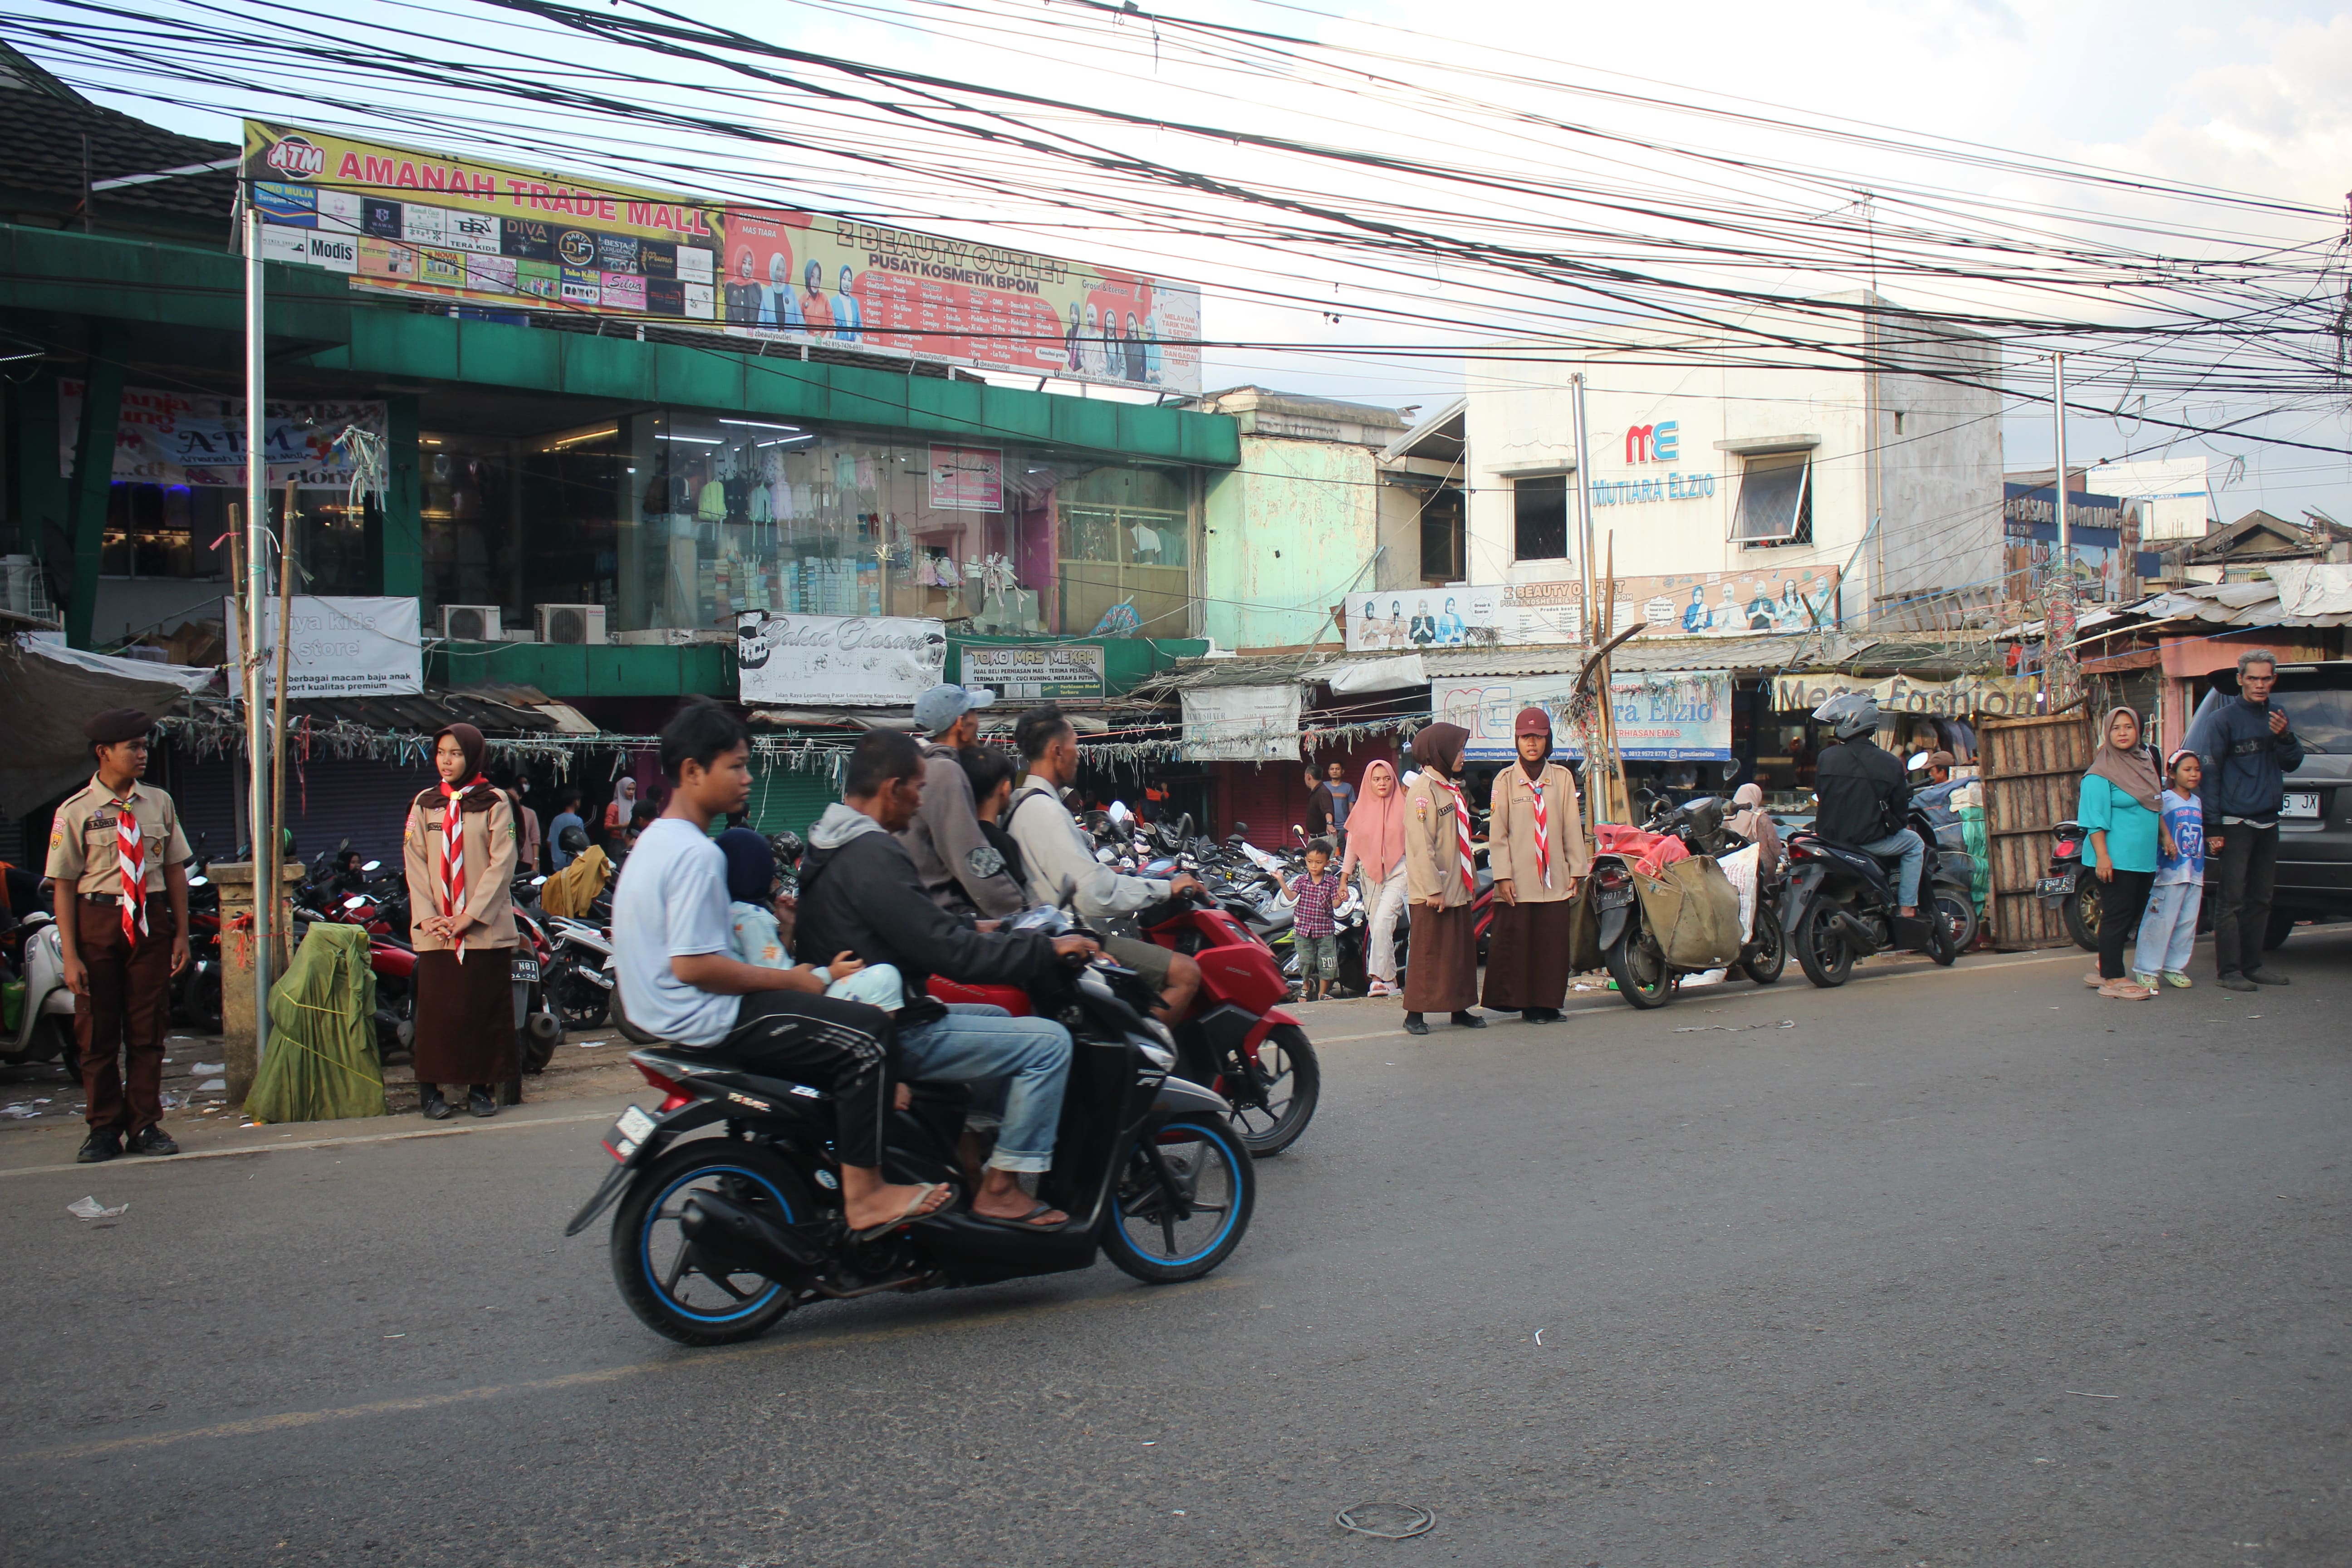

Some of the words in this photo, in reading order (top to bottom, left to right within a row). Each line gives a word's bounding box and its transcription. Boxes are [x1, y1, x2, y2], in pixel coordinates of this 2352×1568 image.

[268, 141, 325, 174] ATM
[257, 182, 282, 194] TOKO
[284, 187, 314, 199] MULIA
[337, 151, 495, 202] AMANAH
[505, 177, 617, 221] TRADE
[627, 200, 710, 236] MALL
[258, 194, 286, 204] Seragam
[761, 216, 781, 226] TOKO
[507, 220, 547, 238] DIVA
[742, 225, 757, 235] MAS
[757, 228, 777, 238] TIARA
[450, 240, 473, 249] TERA
[476, 244, 496, 252] KIDS
[604, 238, 628, 249] BESTA
[311, 239, 353, 261] Modis
[435, 250, 458, 260] NOVIA
[600, 245, 632, 256] KERUDUNG
[859, 225, 968, 267] BEAUTY
[972, 245, 1069, 285] OUTLET
[865, 272, 885, 282] Skincare
[868, 253, 920, 275] PUSAT
[921, 263, 995, 288] KOSMETIK
[997, 277, 1039, 295] BPOM
[610, 276, 642, 290] Silva
[893, 276, 905, 285] Hada
[893, 285, 906, 294] Ovale
[921, 282, 941, 292] Bodycare
[1082, 279, 1102, 291] Grosir
[1102, 283, 1107, 292] &
[1108, 283, 1129, 296] Eceran
[866, 308, 882, 317] Pigeon
[900, 304, 912, 313] Glow
[922, 309, 934, 318] Citra
[946, 314, 961, 323] Eskulin
[1164, 313, 1195, 324] MELAYANI
[1161, 319, 1180, 328] TARIK
[1180, 322, 1198, 332] TUNAI
[755, 330, 792, 341] zbeautyoutlet
[866, 334, 880, 343] Acnes
[1173, 329, 1192, 338] SETOR
[832, 341, 864, 352] 815-7426-6933
[971, 341, 988, 350] Hanasui
[1182, 345, 1199, 353] BANK
[915, 351, 948, 362] zbeautyoutlet
[1164, 349, 1177, 358] DAN
[1177, 352, 1196, 361] GADAI
[979, 360, 1010, 370] zbeautyoutlet
[1172, 358, 1189, 367] EMAS
[2019, 498, 2053, 523] PASAR
[1504, 587, 1514, 600] Z
[1515, 583, 1570, 598] BEAUTY
[1500, 598, 1525, 608] PUSAT
[328, 612, 376, 630] kids
[755, 615, 835, 649] Bakso
[299, 639, 360, 657] store
[970, 650, 1009, 666] TOKO
[1013, 650, 1046, 666] MAS
[1049, 650, 1097, 666] MEKAH
[288, 673, 329, 683] berbagai
[367, 673, 387, 682] baju
[389, 672, 411, 681] anak
[308, 682, 345, 691] kualitas
[348, 681, 388, 691] premium
[1887, 678, 2038, 715] Fashion
[1647, 696, 1713, 723] Elzio
[1657, 729, 1681, 738] EMAS
[2301, 795, 2317, 809] JX
